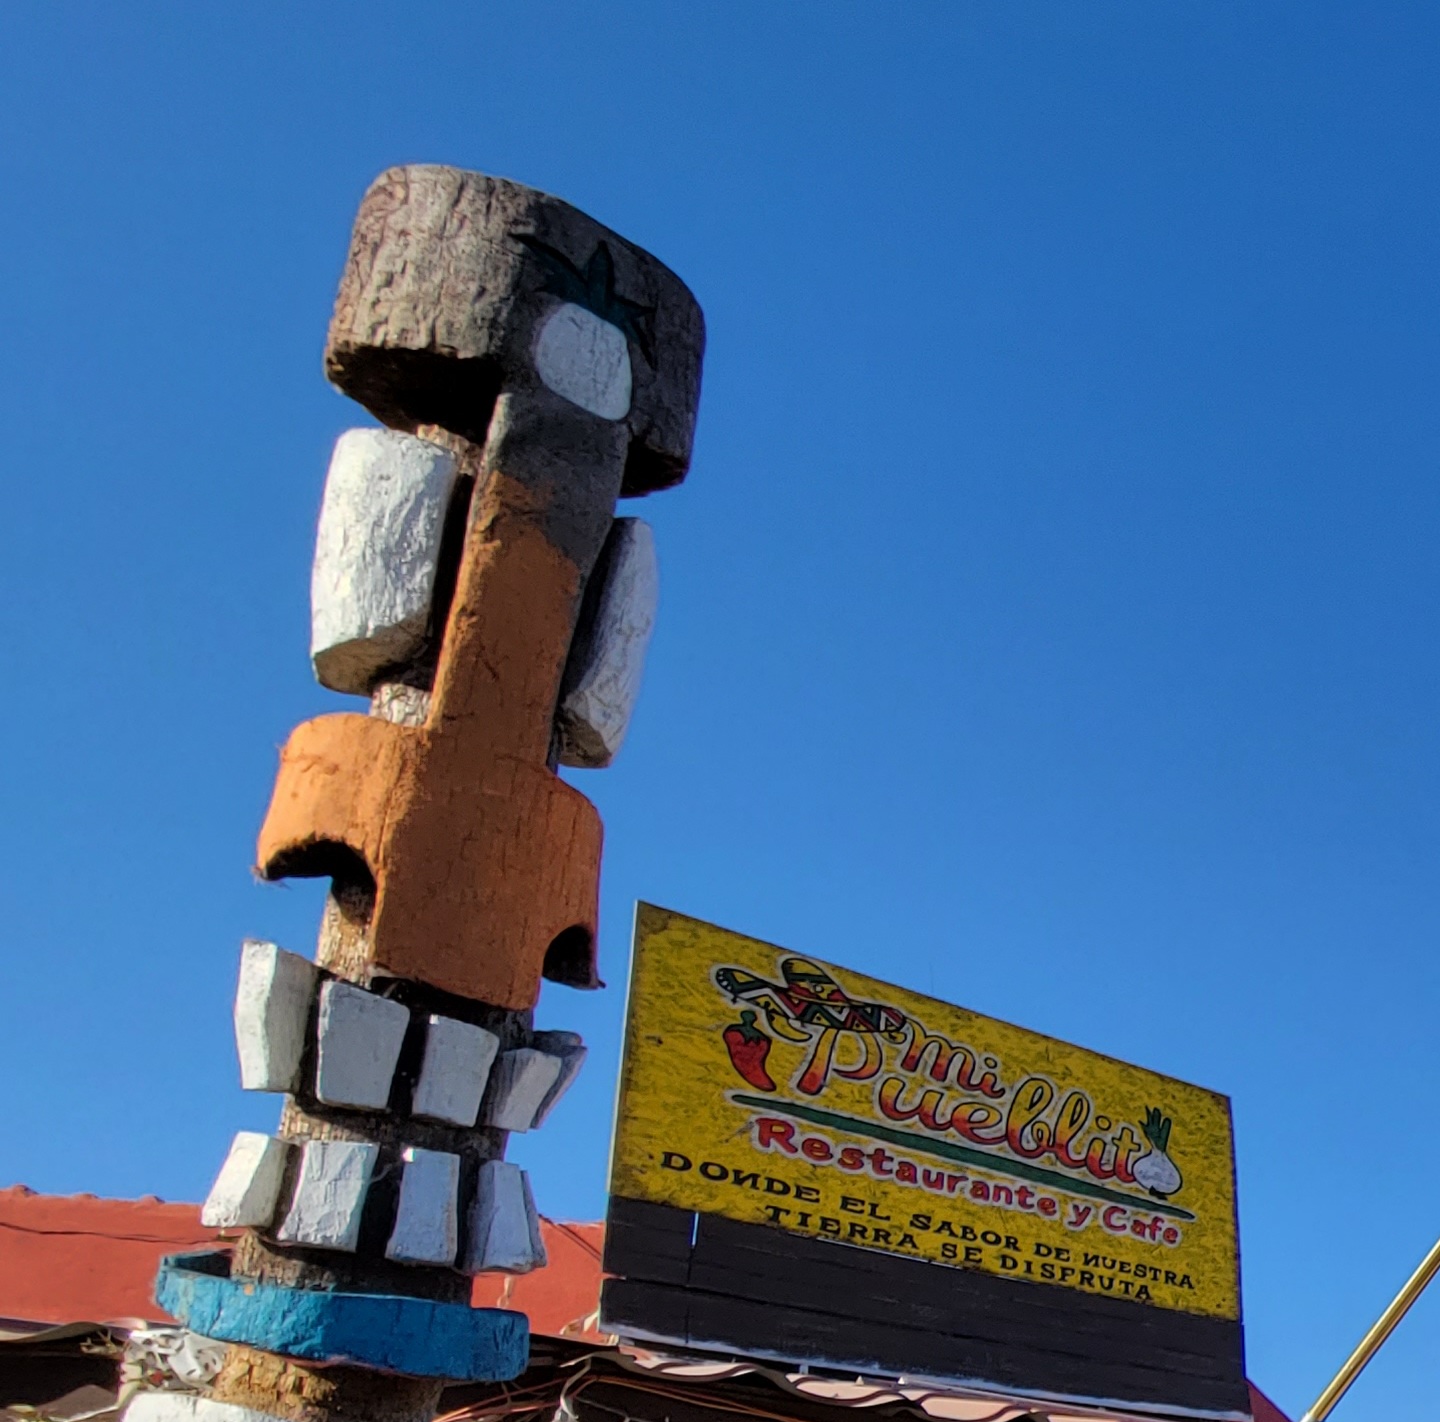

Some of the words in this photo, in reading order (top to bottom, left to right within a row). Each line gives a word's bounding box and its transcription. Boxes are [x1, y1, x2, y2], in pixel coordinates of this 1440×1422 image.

[660, 1151, 821, 1204] DONDE
[840, 1195, 892, 1222] EL
[909, 1212, 1022, 1252] SABOR
[1034, 1242, 1072, 1263] DE
[1082, 1252, 1196, 1290] NUESTRA
[755, 1117, 1058, 1217] Restaurante
[1067, 1203, 1093, 1228] y
[1102, 1205, 1179, 1245] Cafe
[764, 1204, 919, 1250] TIERRA
[941, 1243, 984, 1264] SE
[1000, 1253, 1153, 1301] DISFRUTA
